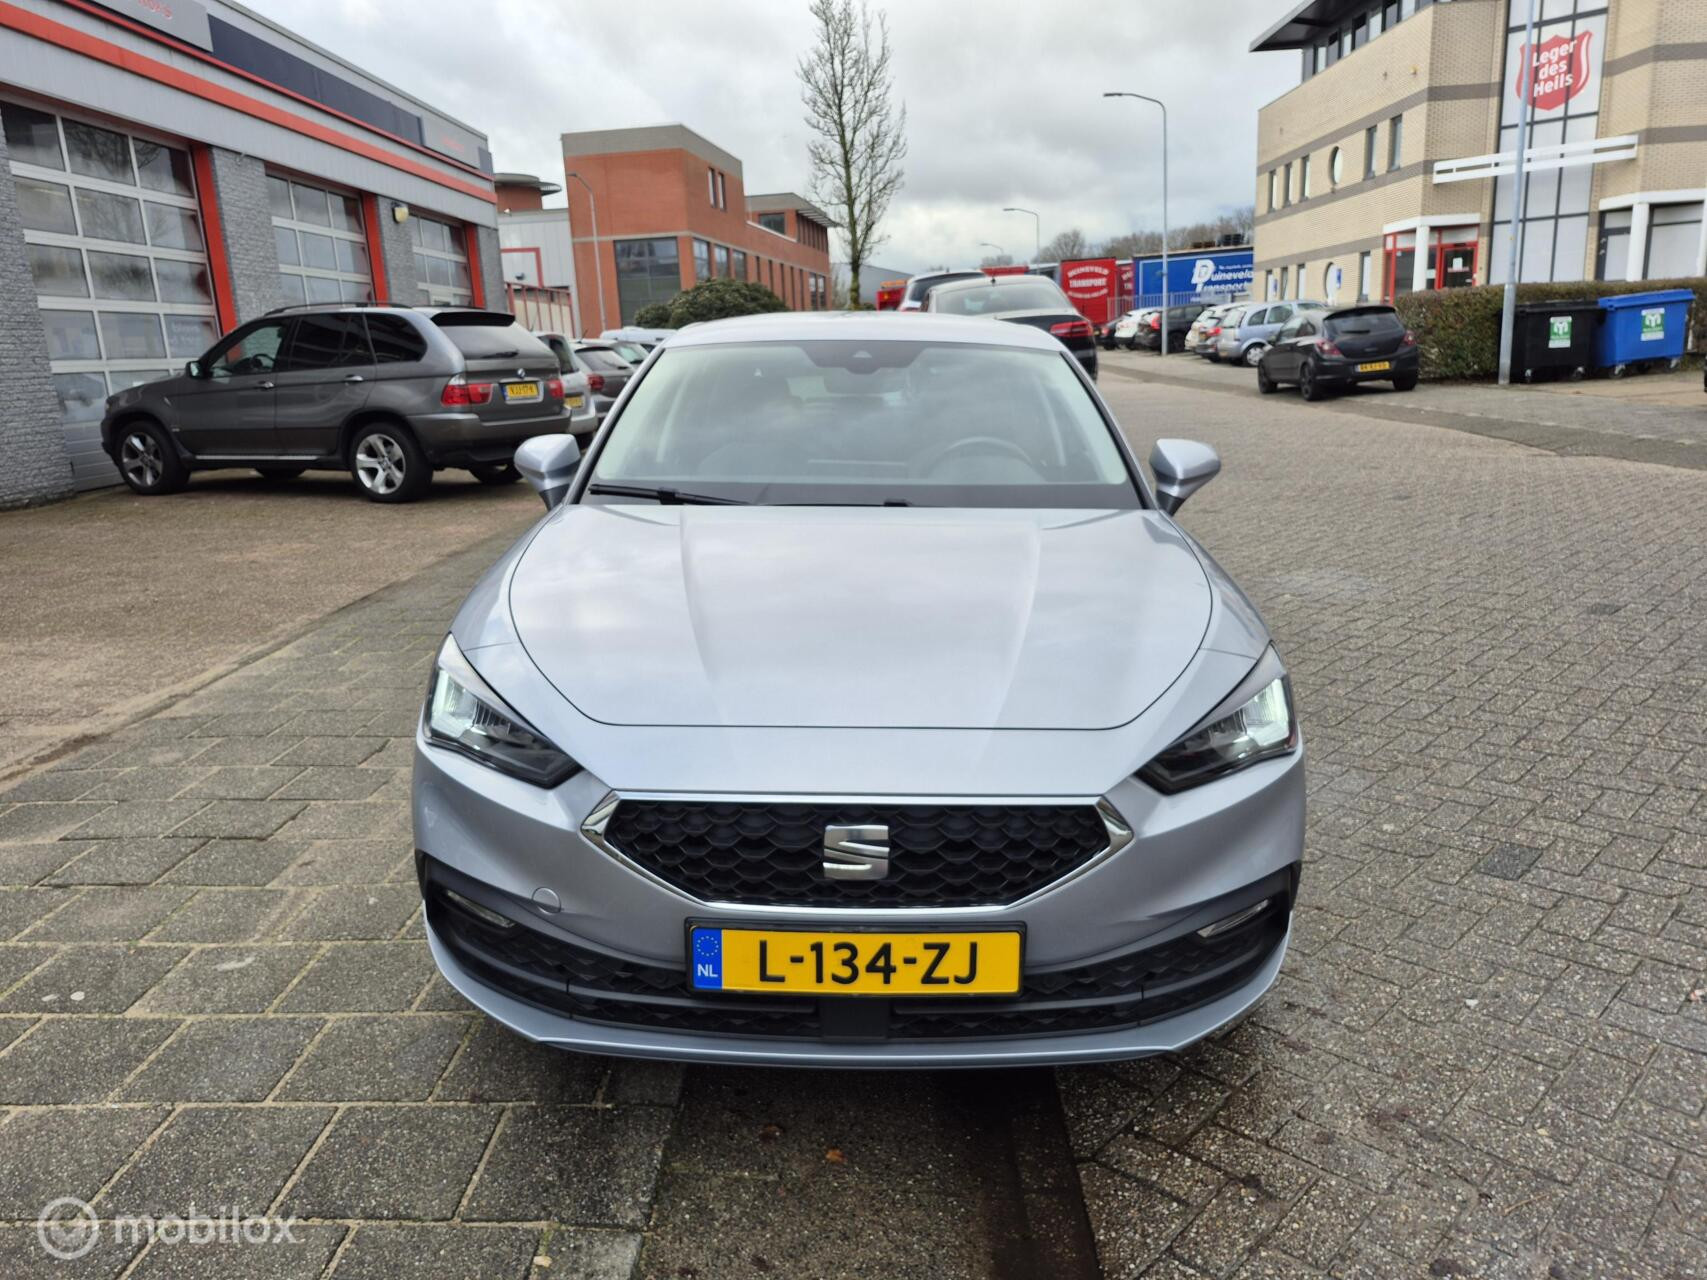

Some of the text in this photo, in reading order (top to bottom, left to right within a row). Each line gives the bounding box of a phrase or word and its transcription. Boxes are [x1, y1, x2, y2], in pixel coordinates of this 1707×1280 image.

[1532, 40, 1577, 68] Leger
[1539, 60, 1567, 79] des
[1533, 73, 1574, 97] Heils
[697, 940, 978, 985] NL L-134-ZJ
